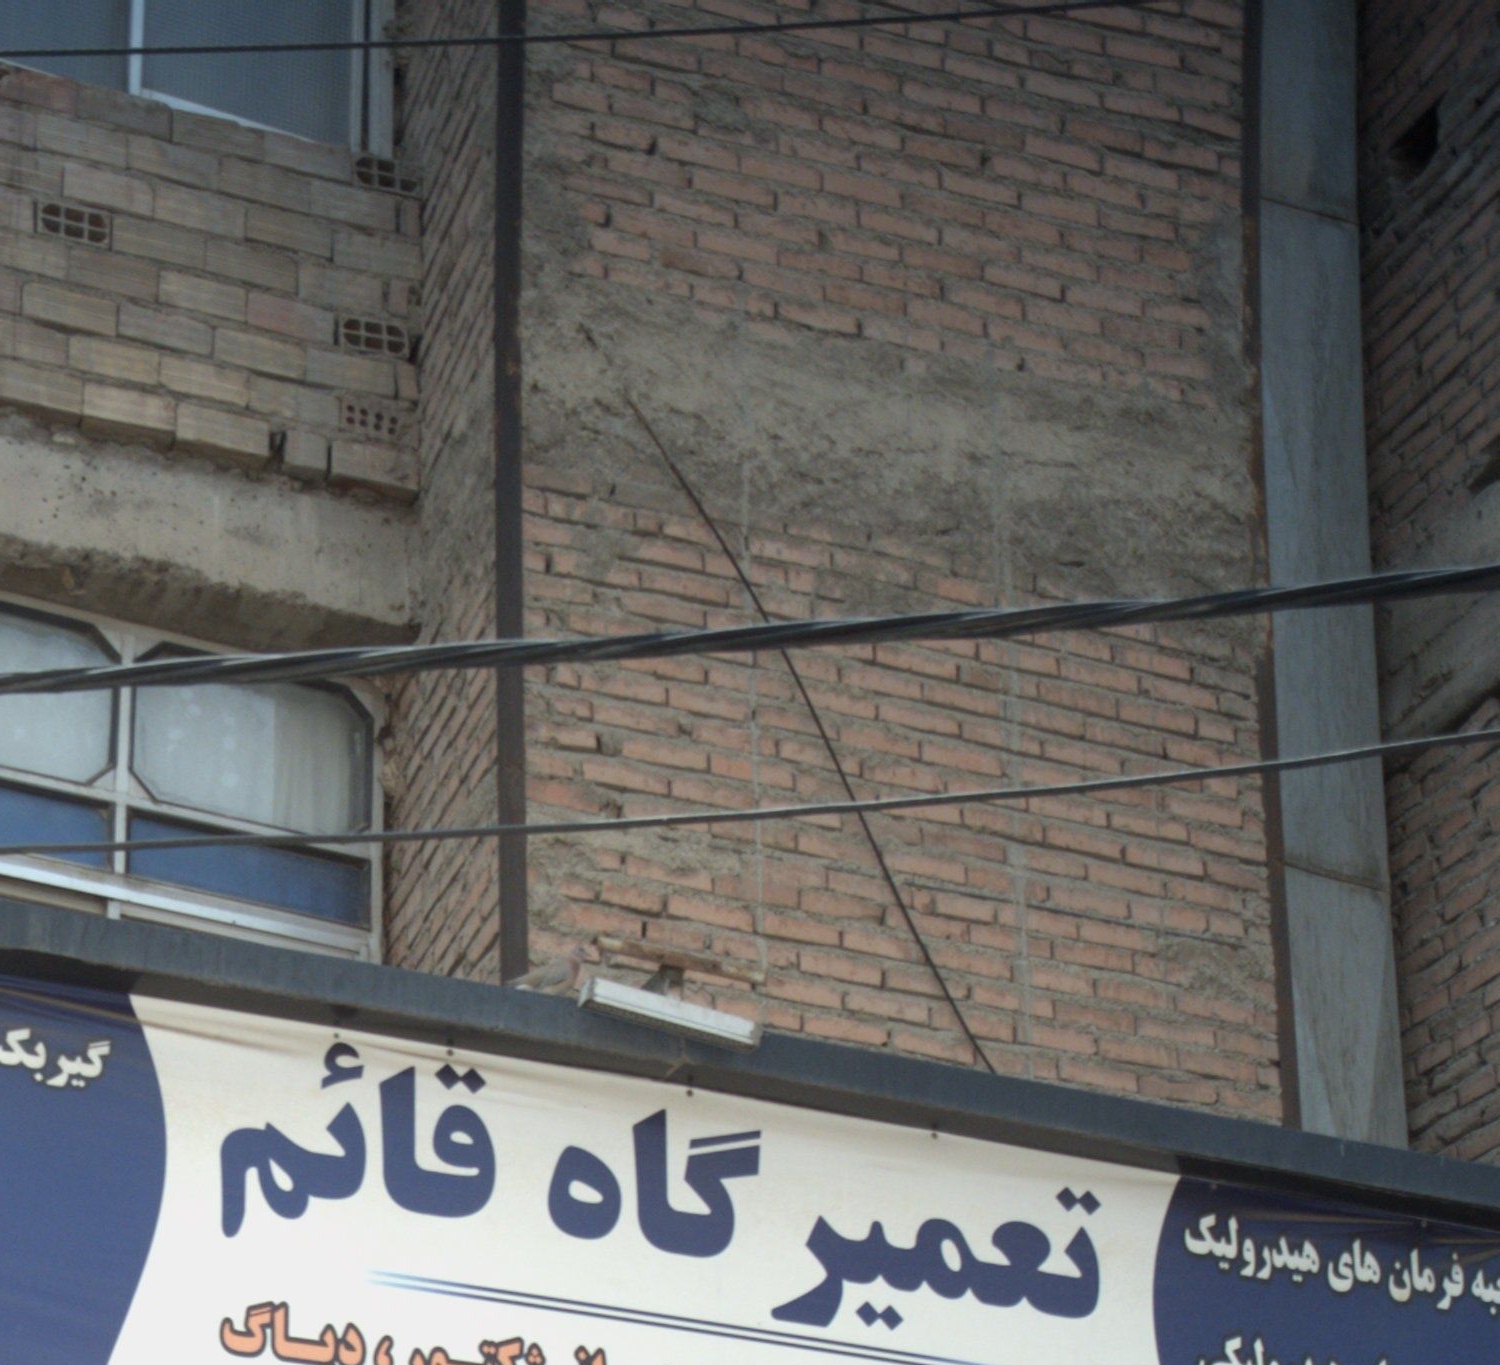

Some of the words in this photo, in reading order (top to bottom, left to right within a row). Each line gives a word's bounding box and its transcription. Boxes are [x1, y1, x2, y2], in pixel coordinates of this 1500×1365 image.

[1184, 1213, 1320, 1284] هیدرولیک
[1327, 1238, 1382, 1293] های
[1388, 1248, 1465, 1310] فرمان
